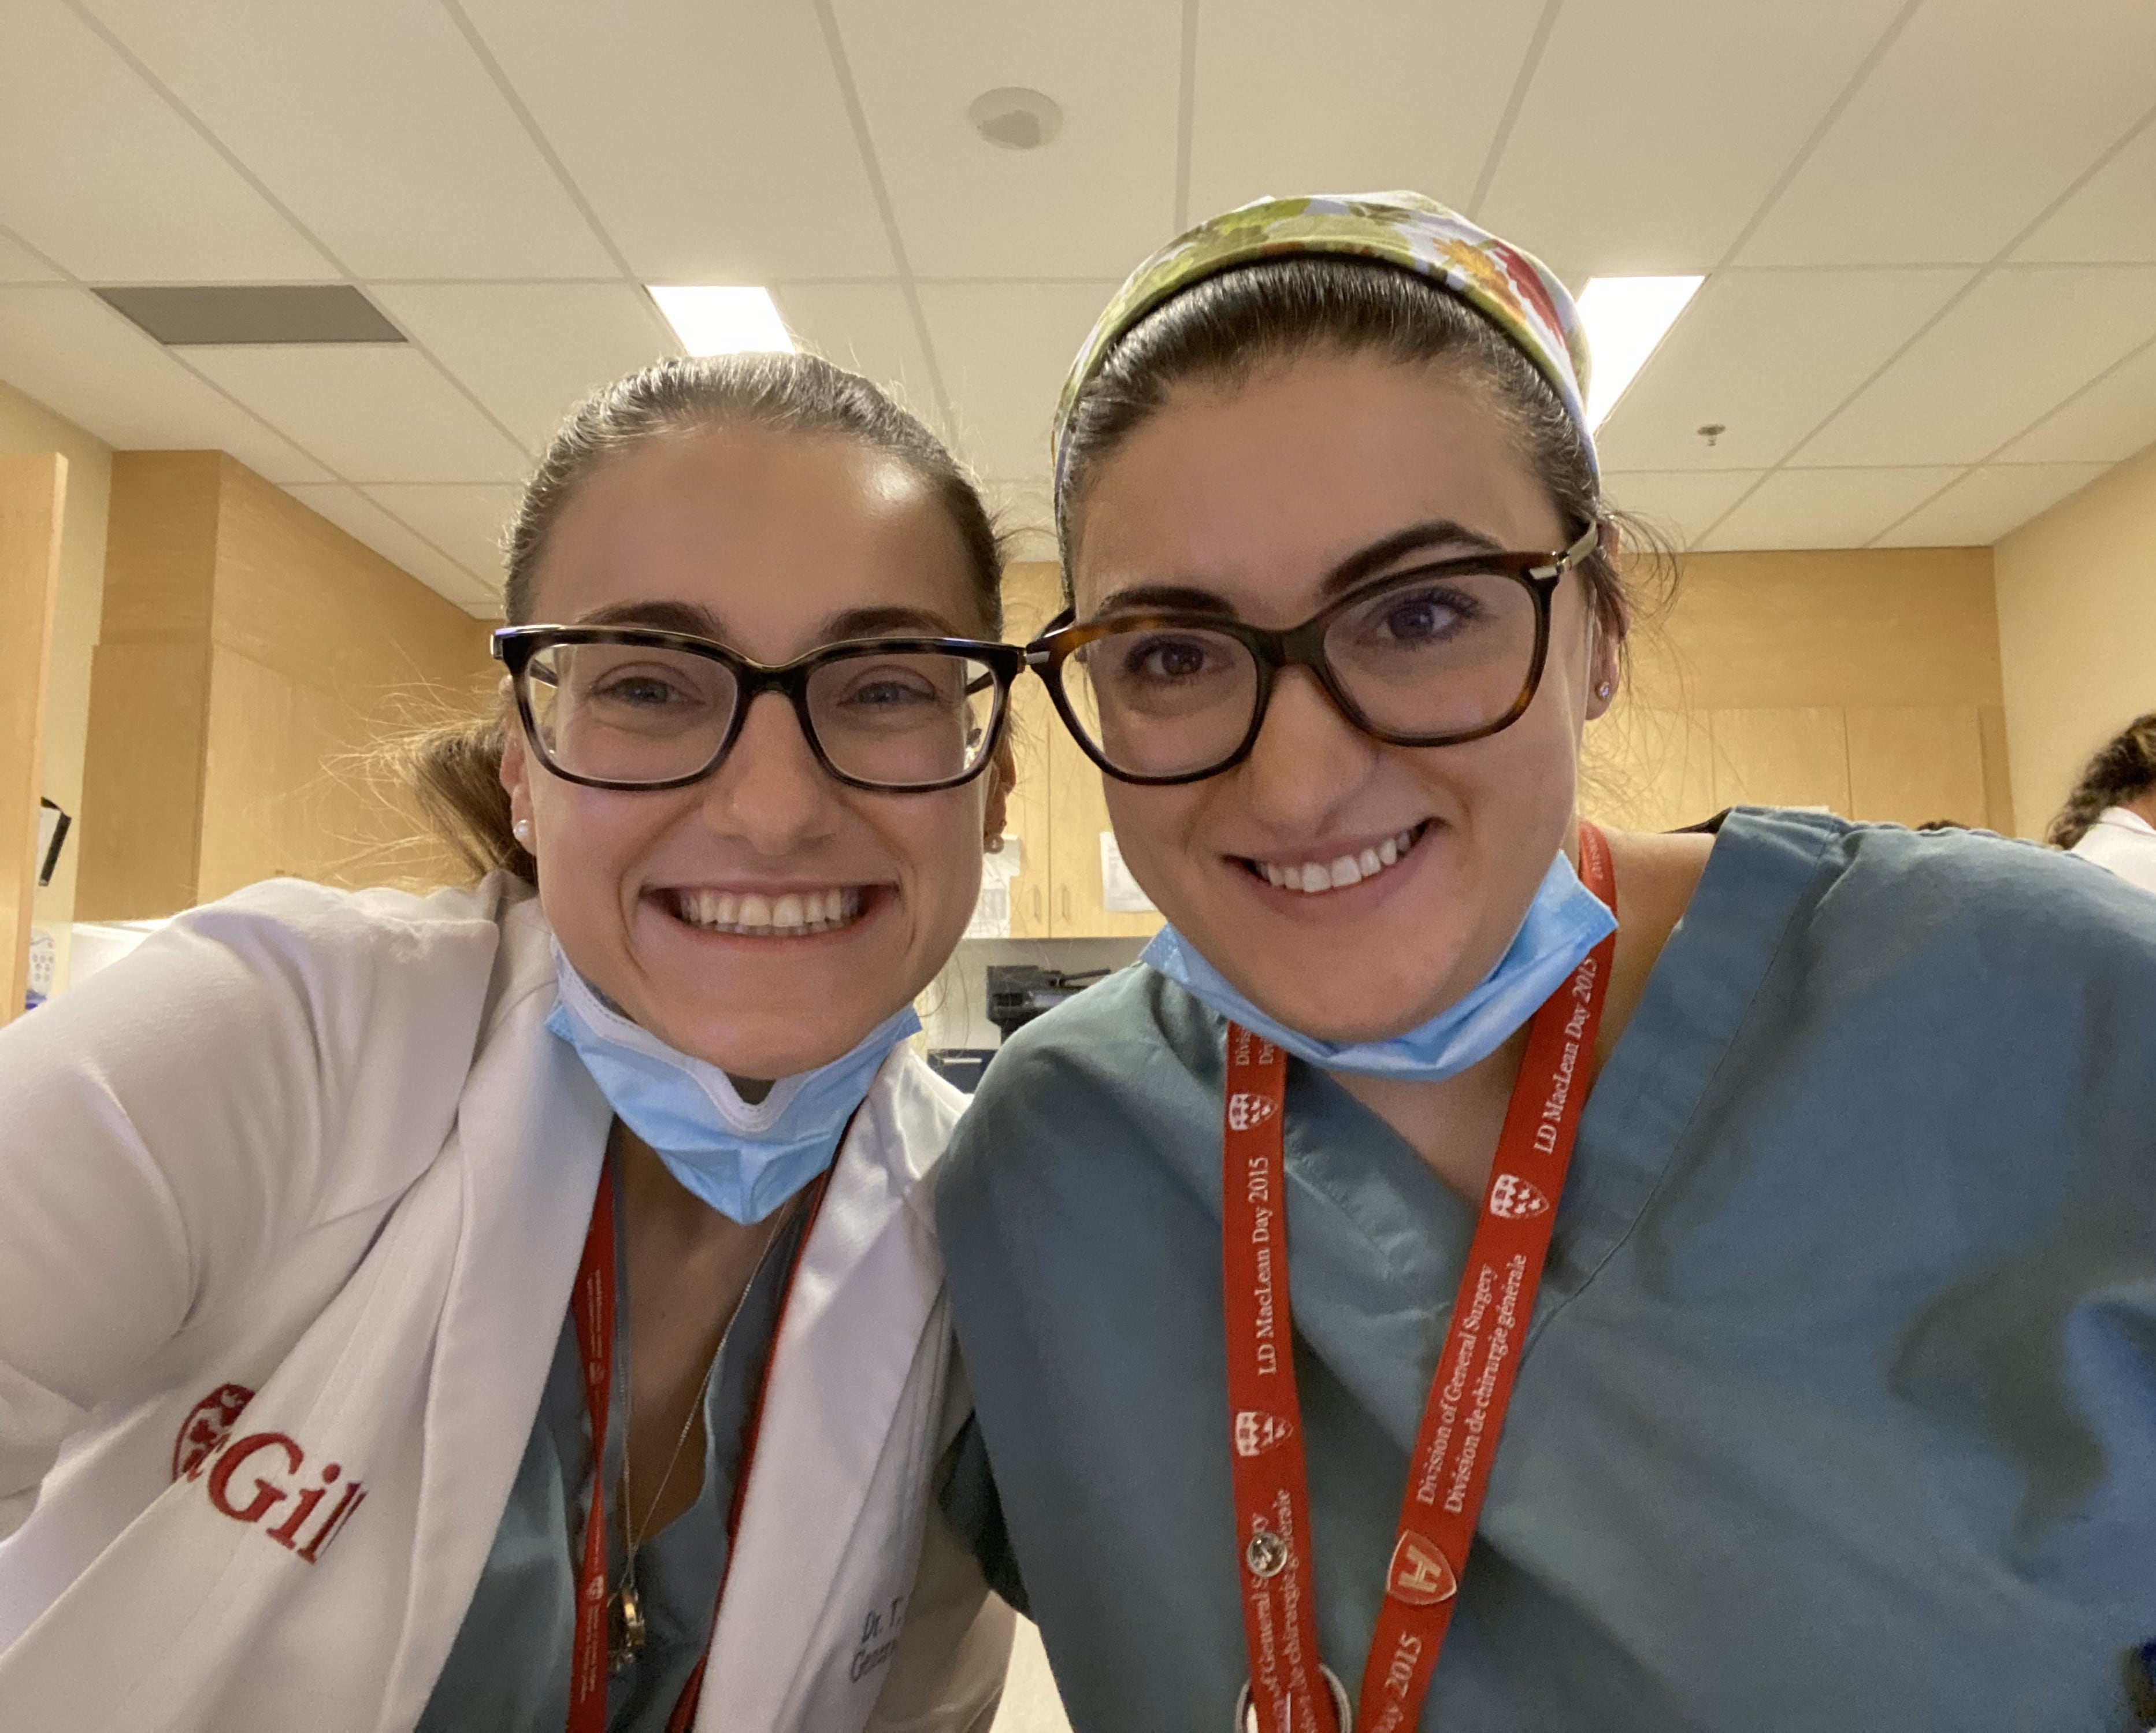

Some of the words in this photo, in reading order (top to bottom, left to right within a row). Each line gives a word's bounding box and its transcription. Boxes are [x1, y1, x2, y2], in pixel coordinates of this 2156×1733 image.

[1571, 957, 1598, 1004] 2015
[1565, 1002, 1590, 1040] Day
[1542, 1041, 1580, 1122] MacLean
[1533, 1124, 1557, 1155] LD
[1248, 1156, 1270, 1203] 2015
[1252, 1207, 1273, 1244] Day
[1254, 1248, 1275, 1339] MacLean
[1463, 1263, 1498, 1331] Surgery
[1496, 1254, 1527, 1328] générale
[1257, 1343, 1276, 1376] LD
[1443, 1331, 1477, 1402] General
[1472, 1327, 1509, 1408] chirurgie
[1439, 1398, 1458, 1424] of
[1464, 1408, 1487, 1434] de
[1417, 1426, 1452, 1506] Division
[1443, 1435, 1481, 1514] Division
[1385, 1630, 1423, 1698] 2015
